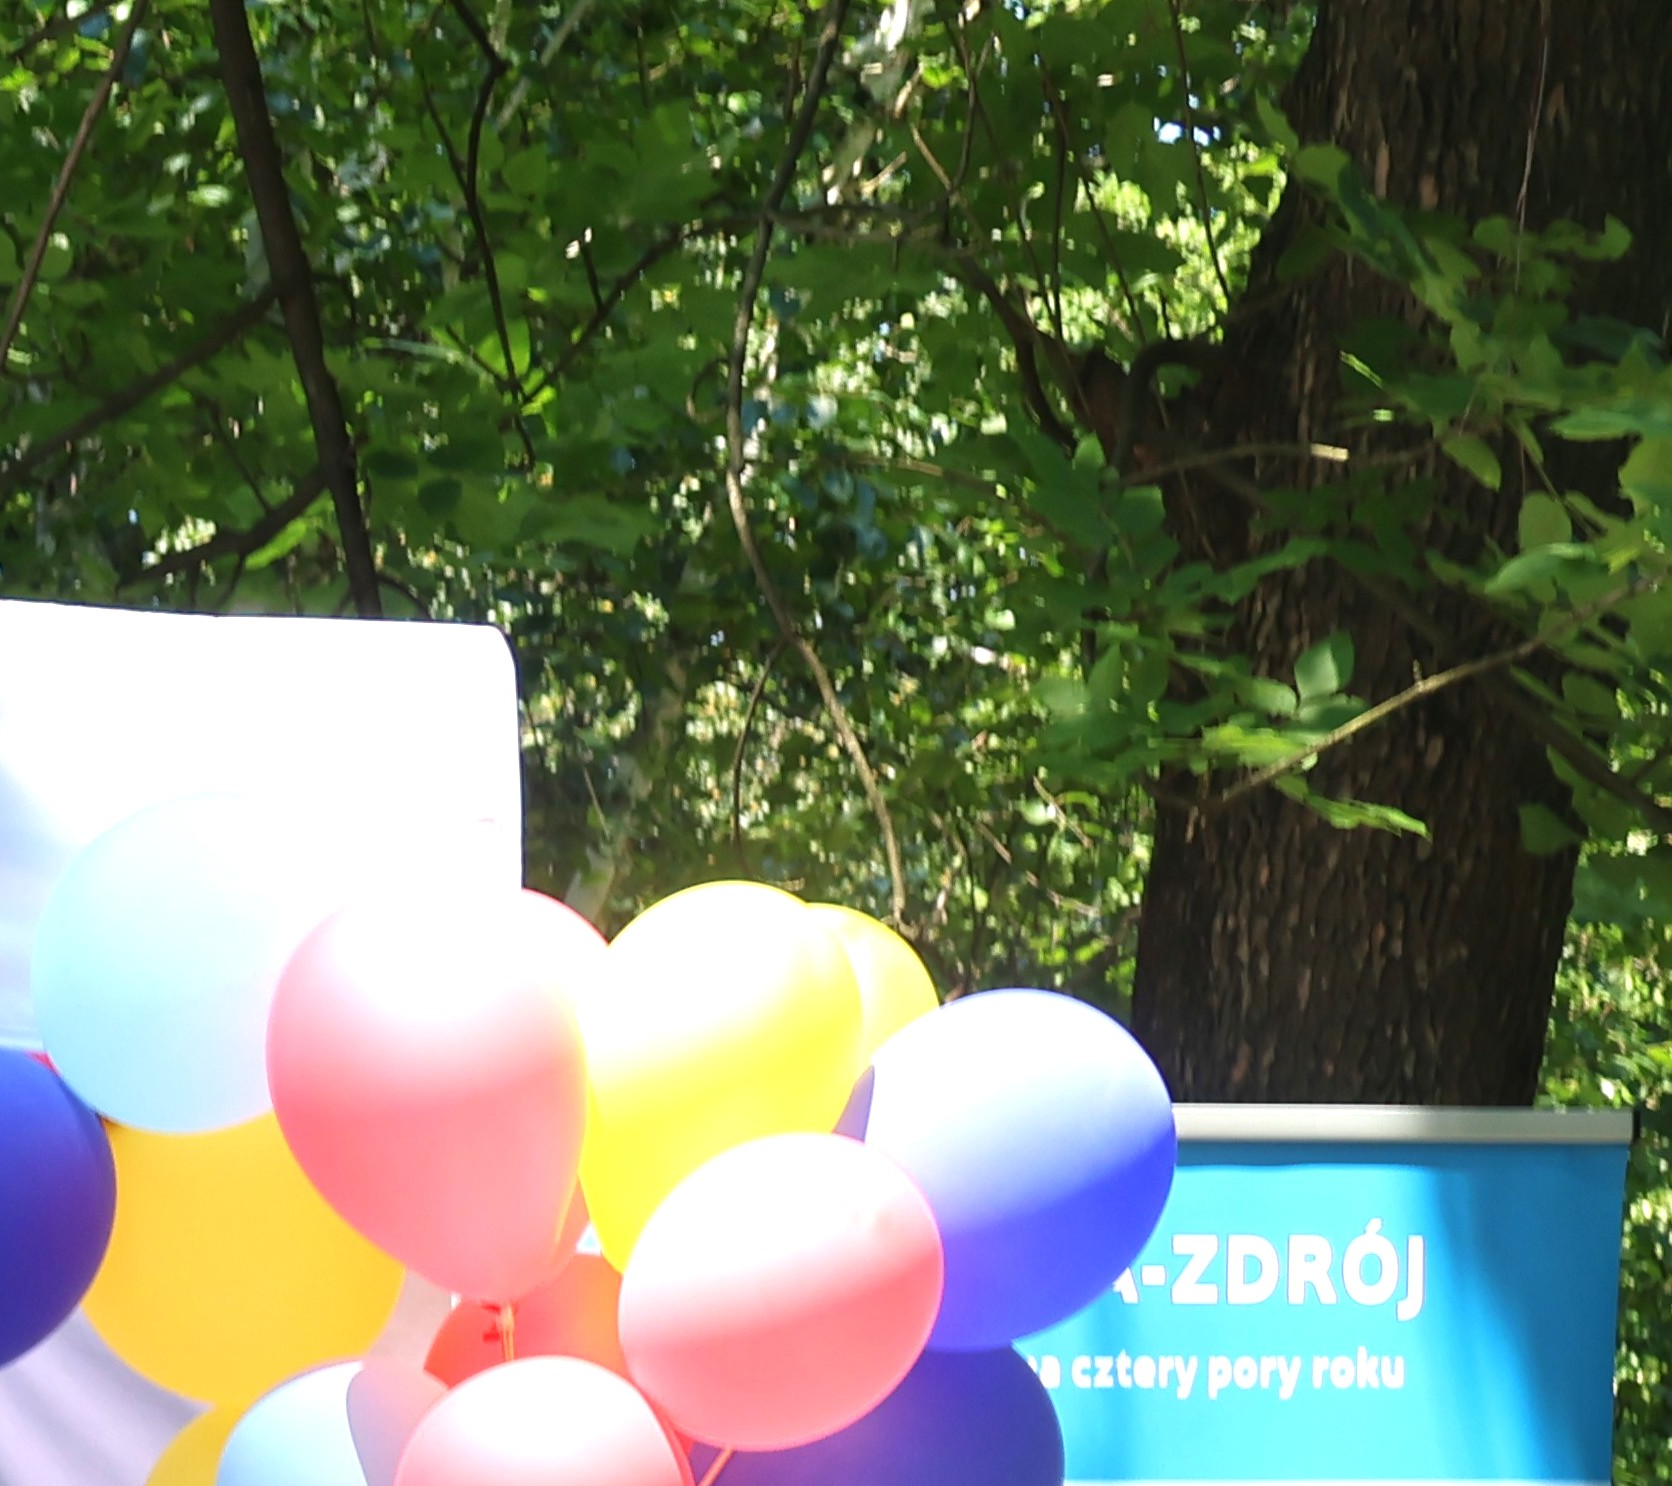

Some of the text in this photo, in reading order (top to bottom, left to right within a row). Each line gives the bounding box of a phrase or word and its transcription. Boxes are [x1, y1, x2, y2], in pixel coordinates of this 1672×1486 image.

[1071, 1348, 1198, 1400] cztery
[1208, 1353, 1302, 1401] pory
[1312, 1346, 1406, 1390] roku
